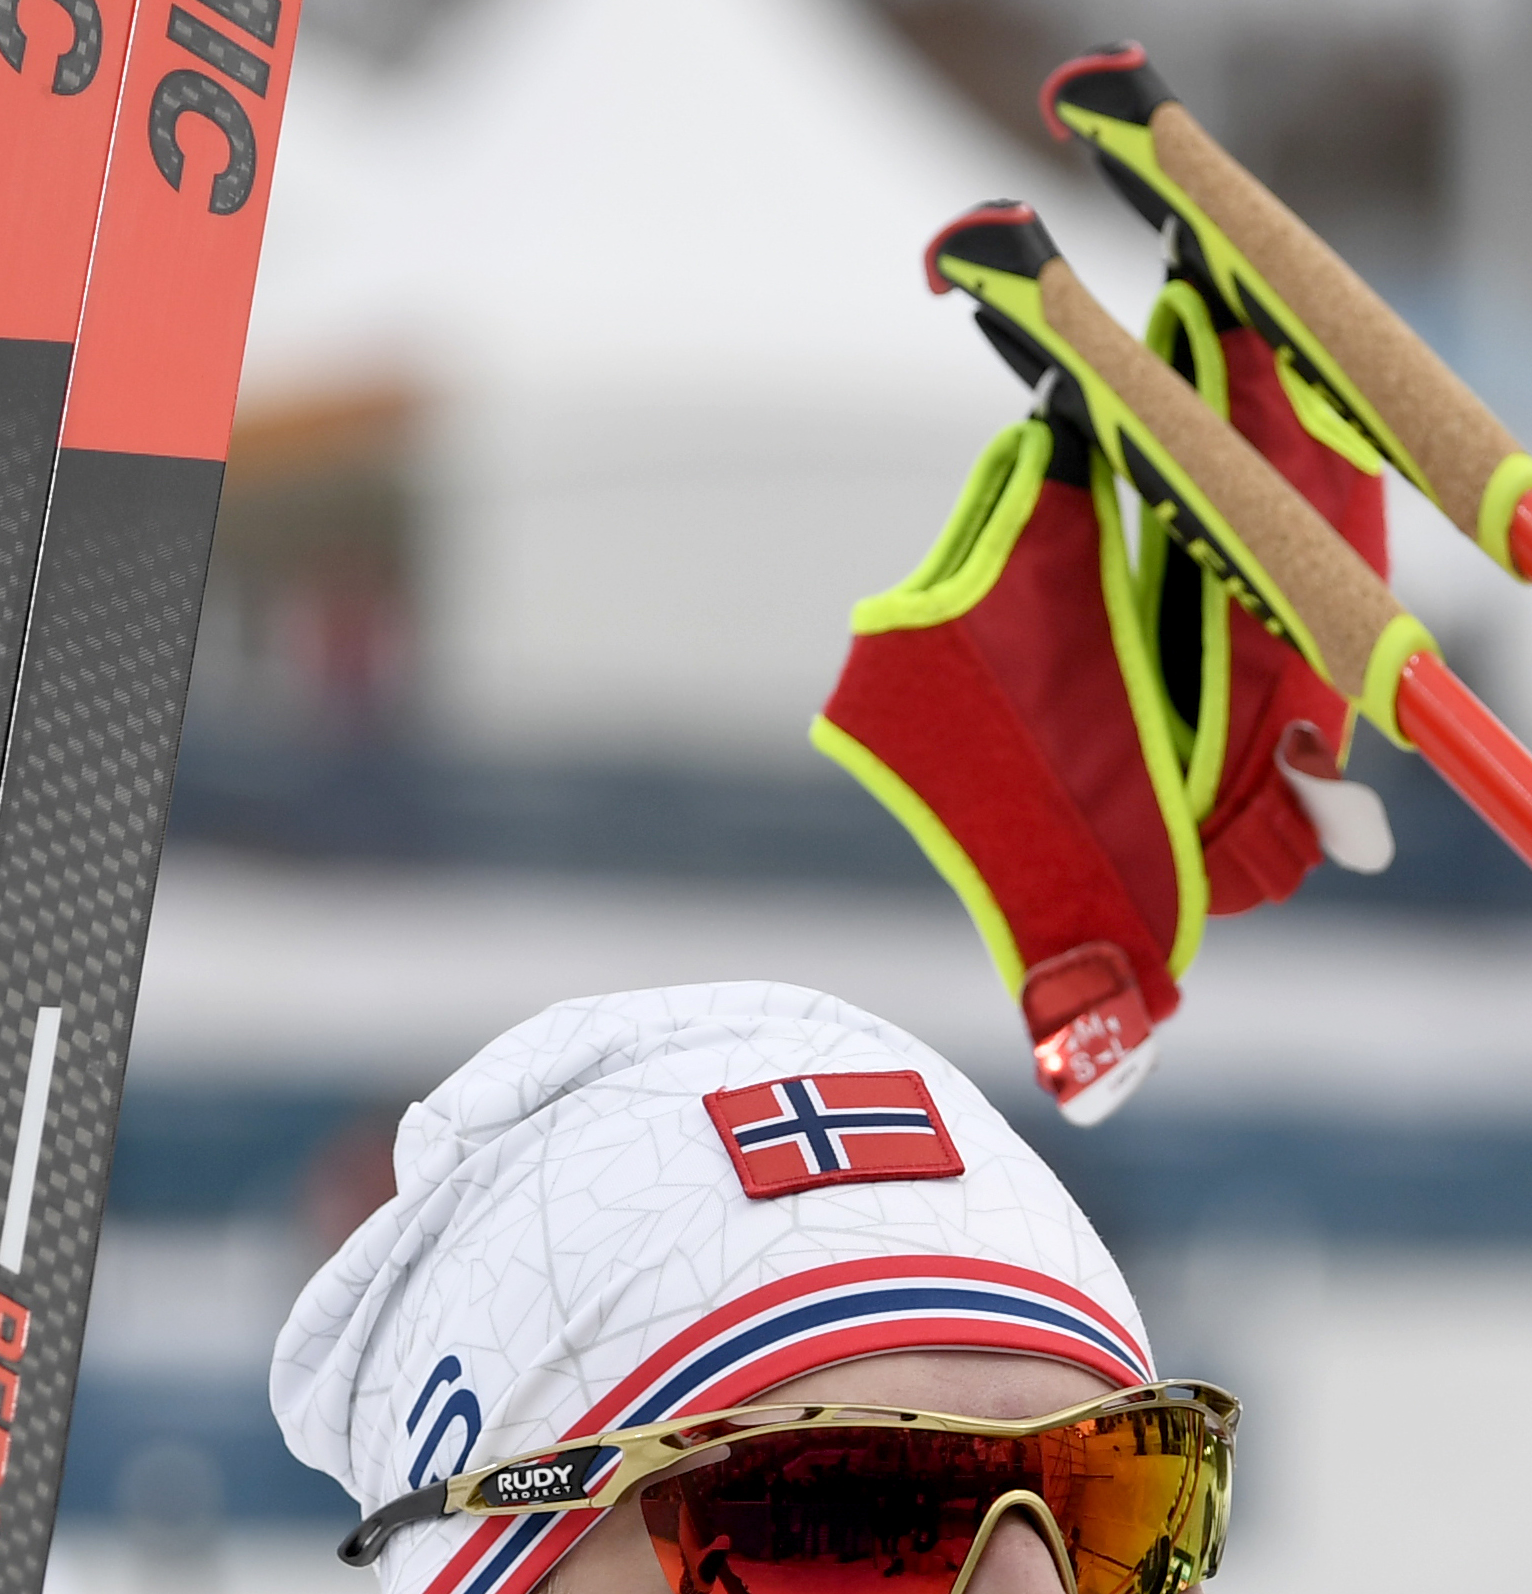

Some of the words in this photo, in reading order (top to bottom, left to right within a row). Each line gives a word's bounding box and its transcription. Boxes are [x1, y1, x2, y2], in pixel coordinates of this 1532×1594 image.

[148, 0, 282, 216] IC
[498, 1464, 573, 1492] RUDY
[502, 1485, 571, 1501] PROJECT
